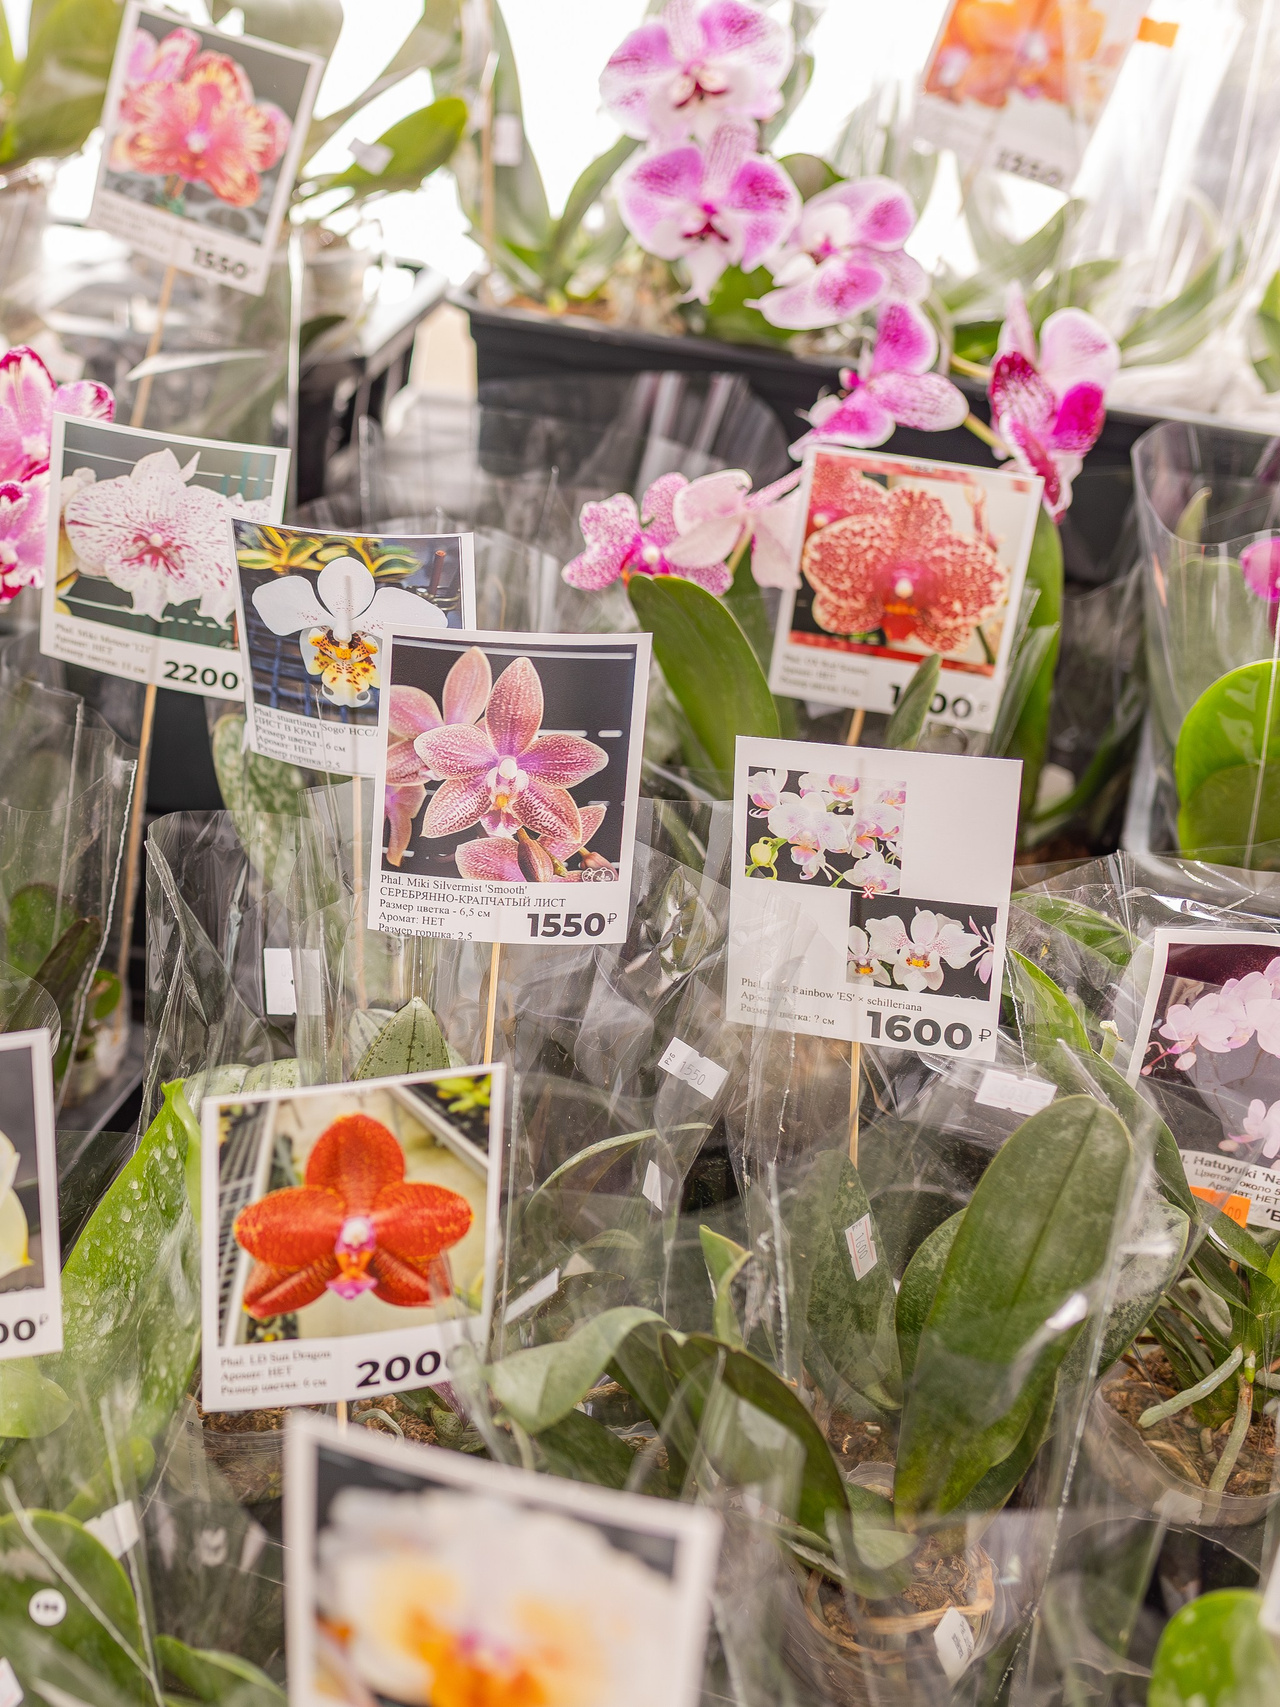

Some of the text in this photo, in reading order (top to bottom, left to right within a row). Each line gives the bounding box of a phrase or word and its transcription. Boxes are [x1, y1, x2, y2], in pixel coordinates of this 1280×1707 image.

[164, 661, 238, 689] 2200
[381, 875, 528, 895] Phal. Miki Silvermist 'Smooth'
[380, 887, 566, 907] СЕРЕБРЯННО-КРАПЧАТЫЙ ЛИСТ
[380, 899, 414, 913] Размер
[416, 906, 450, 915] цветка
[459, 907, 475, 917] 6,5
[379, 912, 445, 926] Аромат: НЕТ
[378, 924, 473, 940] Размер горшка: 2,5
[792, 985, 834, 999] Rainbow
[836, 992, 855, 1002] 'ES'
[867, 997, 922, 1012] schilleriana
[822, 1017, 834, 1025] см
[866, 1010, 973, 1051] 1600
[680, 1061, 705, 1085] 1550
[1194, 1156, 1257, 1179] Hatuyuki
[1240, 1181, 1271, 1193] около
